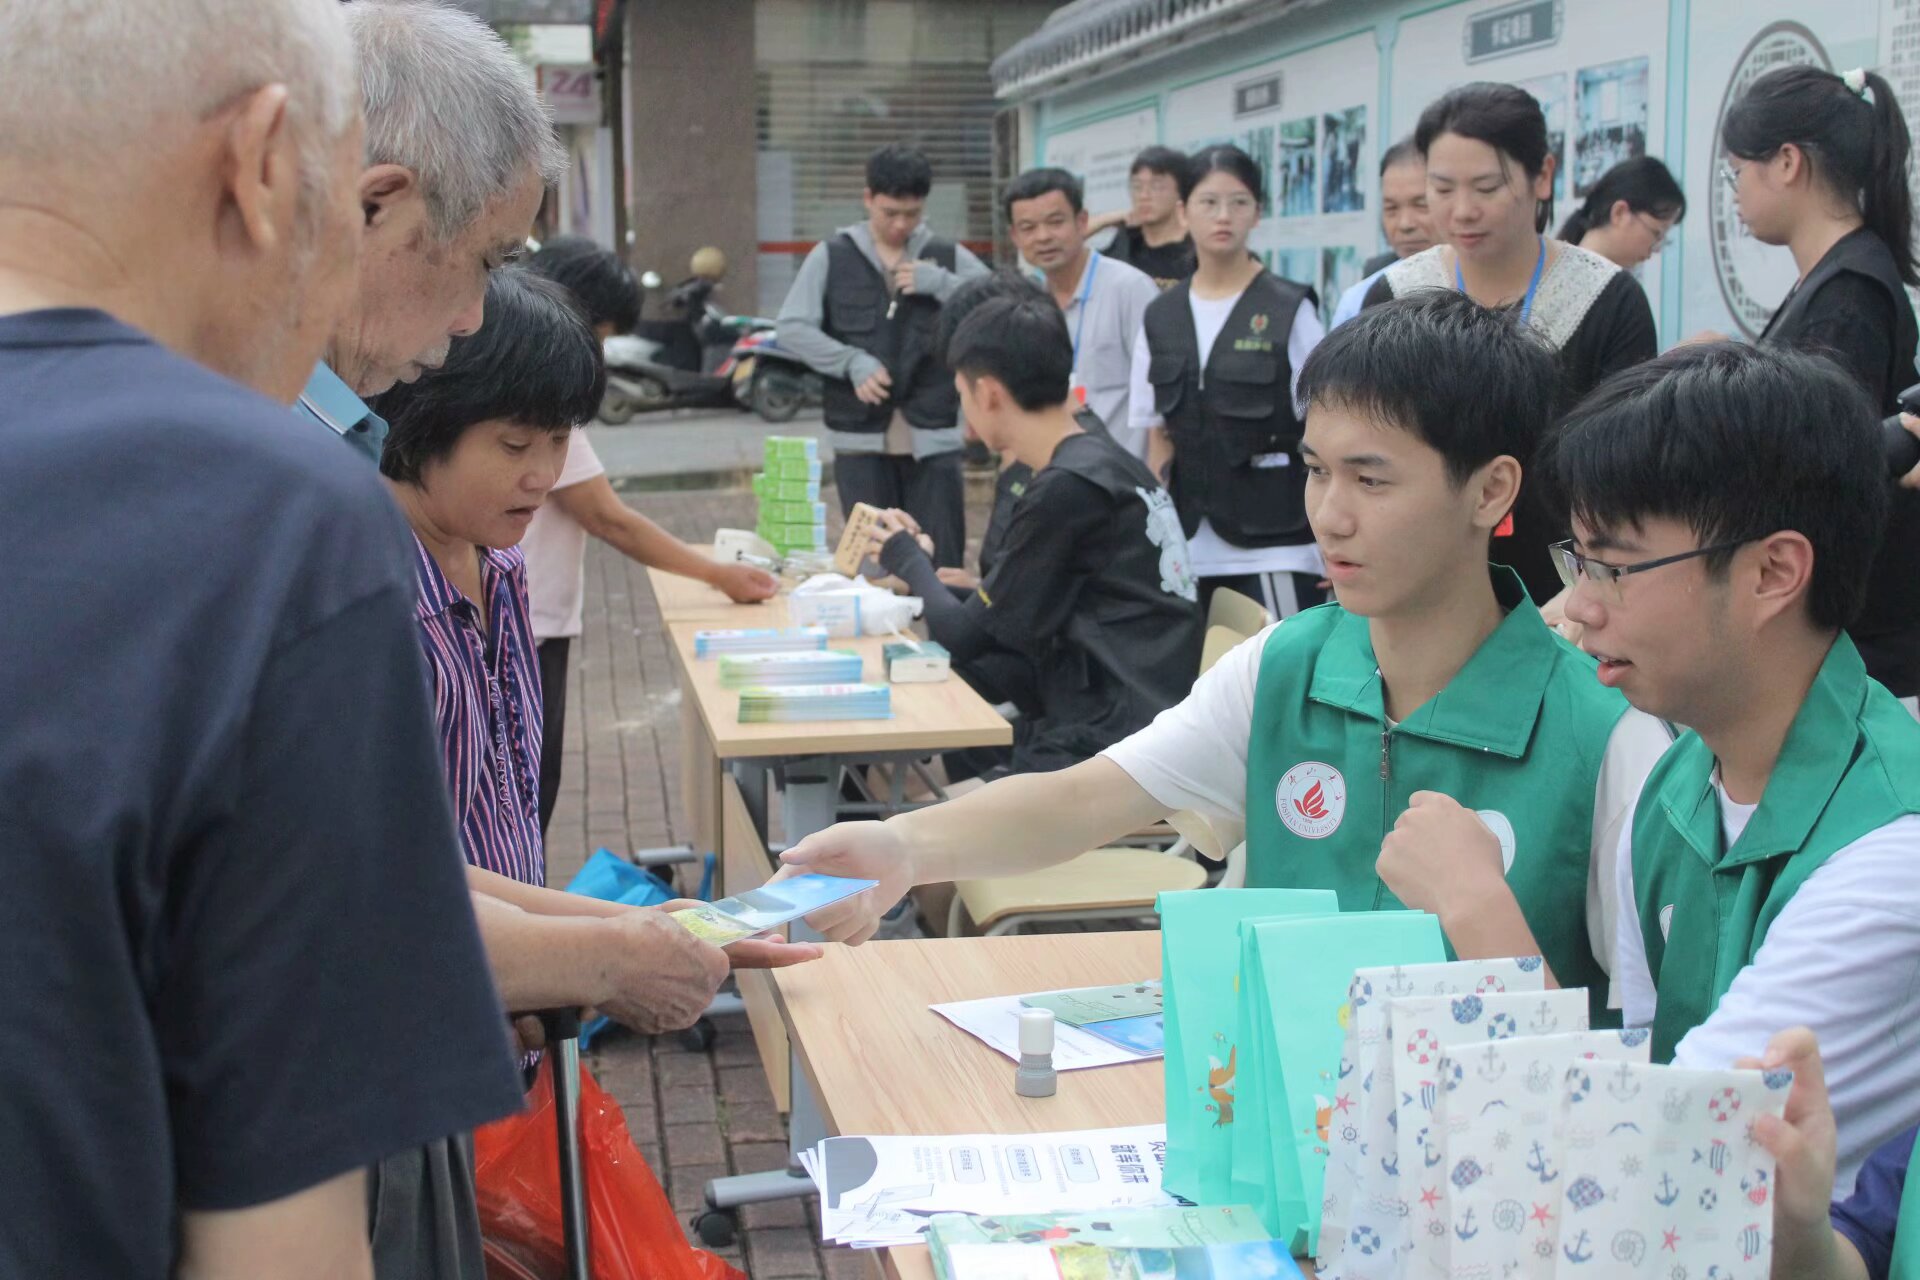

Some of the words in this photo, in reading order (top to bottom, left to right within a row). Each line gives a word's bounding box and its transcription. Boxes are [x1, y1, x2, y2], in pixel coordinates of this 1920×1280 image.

[550, 70, 592, 98] 24
[1280, 798, 1298, 827] FOSHAN
[1298, 817, 1338, 834] UNIVERSITY
[1110, 1144, 1150, 1184] 就等你来
